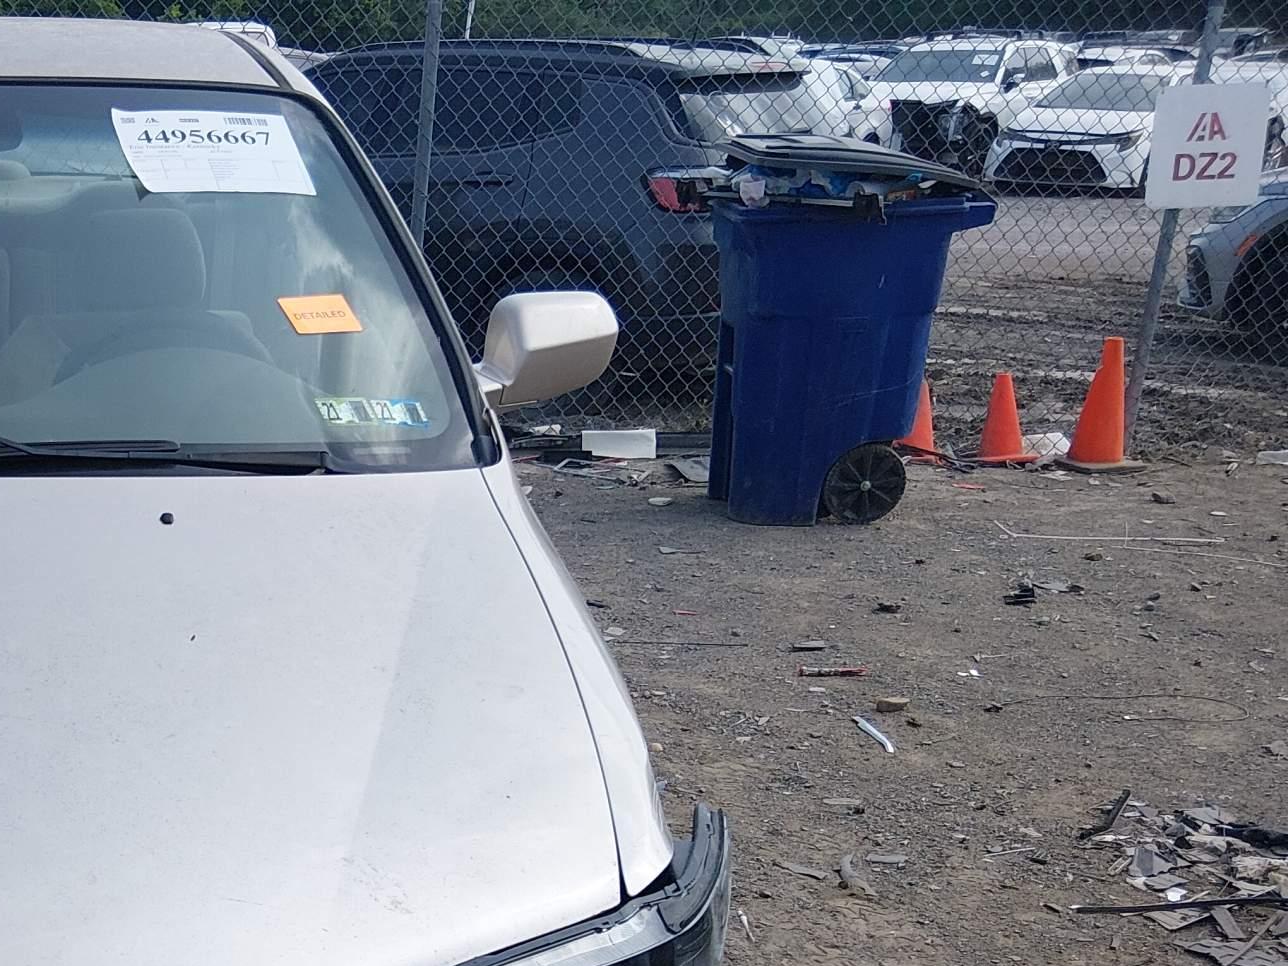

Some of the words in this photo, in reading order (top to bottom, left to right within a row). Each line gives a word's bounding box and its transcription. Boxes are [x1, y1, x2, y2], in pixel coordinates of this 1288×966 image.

[137, 129, 270, 146] 44956667
[1172, 152, 1237, 181] DZ2
[294, 310, 346, 320] DETAILED
